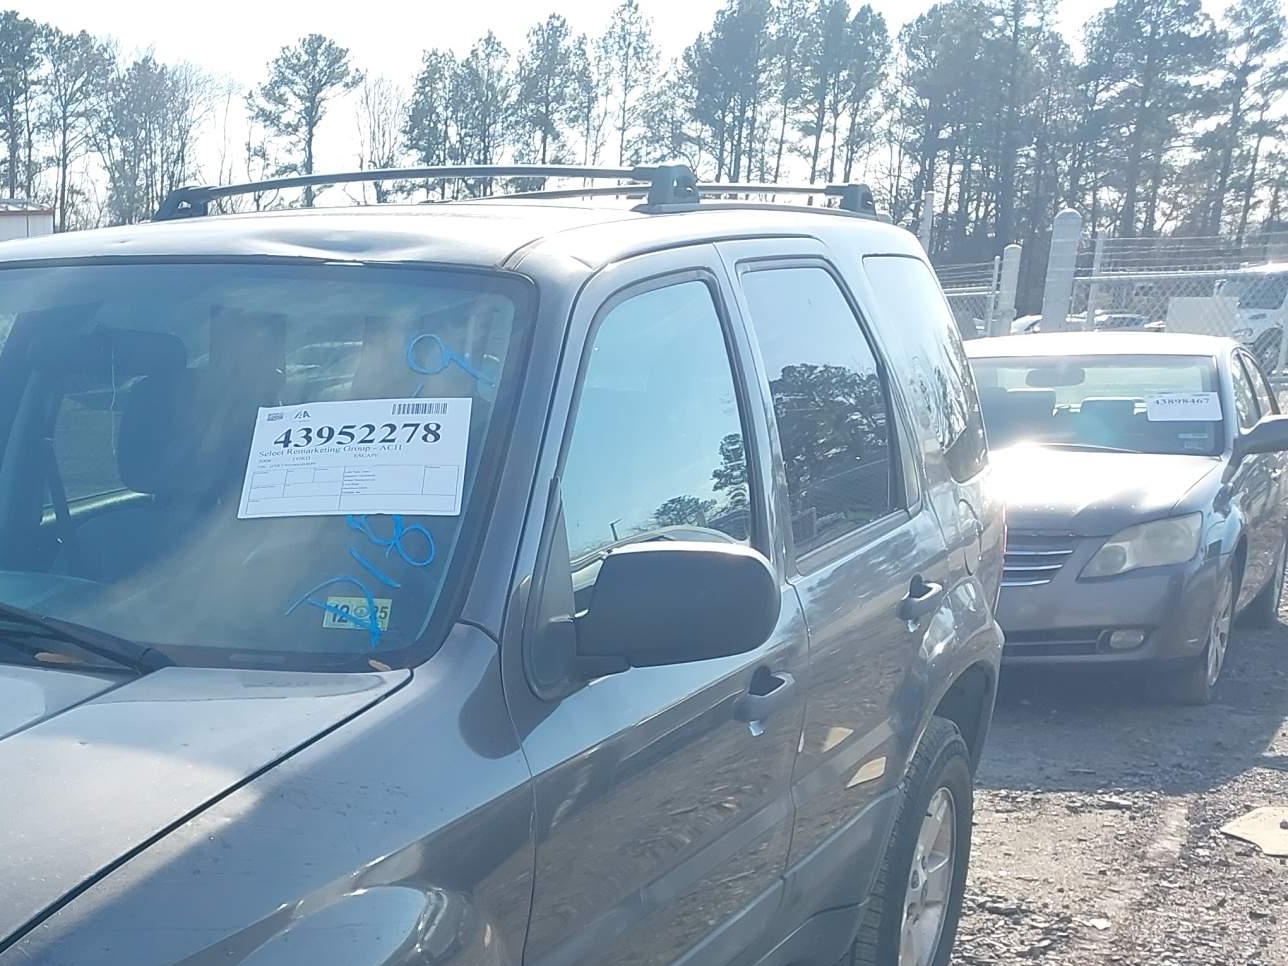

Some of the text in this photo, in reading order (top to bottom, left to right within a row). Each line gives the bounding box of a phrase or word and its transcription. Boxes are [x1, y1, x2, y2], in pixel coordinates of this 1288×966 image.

[274, 422, 442, 449] 43952278
[258, 449, 285, 458] Select
[286, 446, 341, 456] Remarketing
[343, 444, 371, 453] Group
